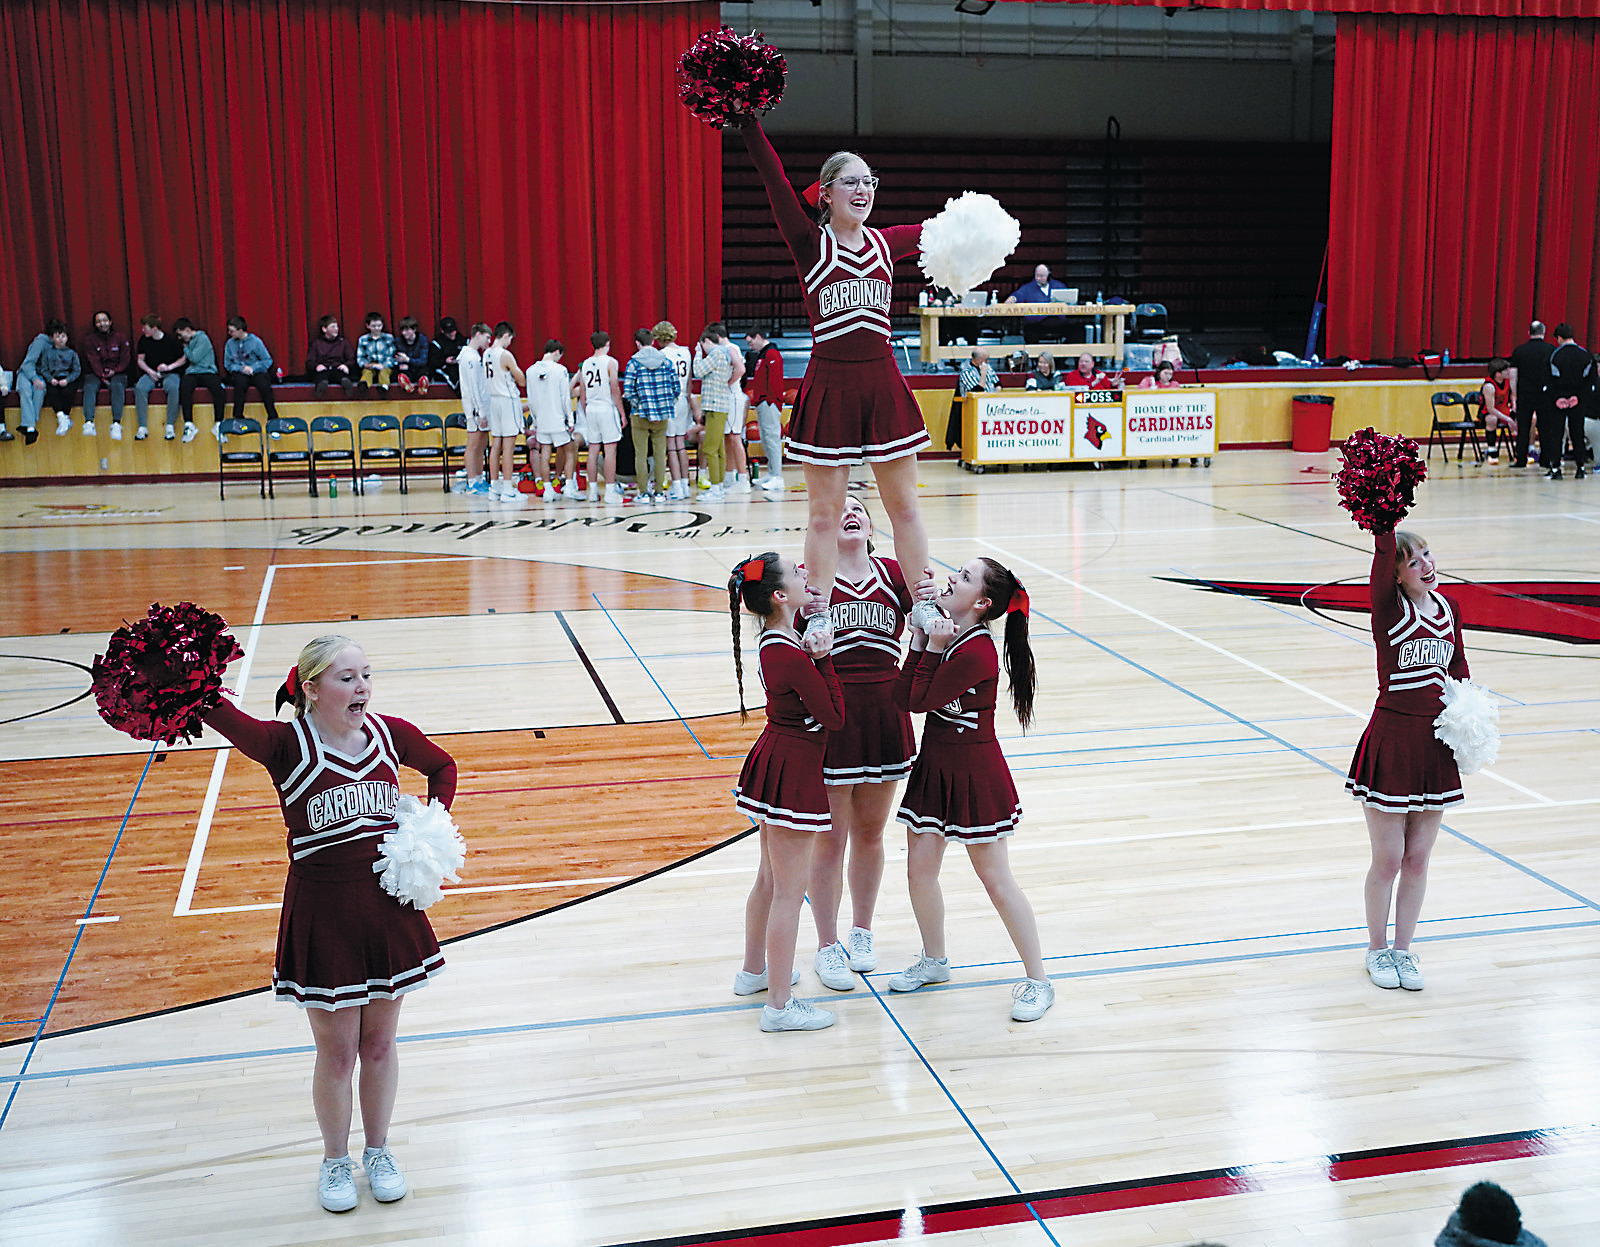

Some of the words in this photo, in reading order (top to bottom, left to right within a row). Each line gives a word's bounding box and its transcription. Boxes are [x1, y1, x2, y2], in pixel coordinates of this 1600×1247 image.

[485, 361, 494, 379] 15
[586, 369, 602, 388] 24
[986, 403, 1027, 417] Welcome
[1134, 405, 1165, 414] HOME
[1168, 405, 1183, 414] OF
[1186, 404, 1207, 413] THE
[981, 419, 1065, 436] LANGDON
[1128, 415, 1213, 432] CARDINALS
[987, 439, 1015, 448] HIGH
[1018, 438, 1062, 447] SCHOOL
[288, 510, 713, 547] Cardinals
[830, 601, 897, 635] ARDINALS
[1398, 638, 1455, 669] CARDIN
